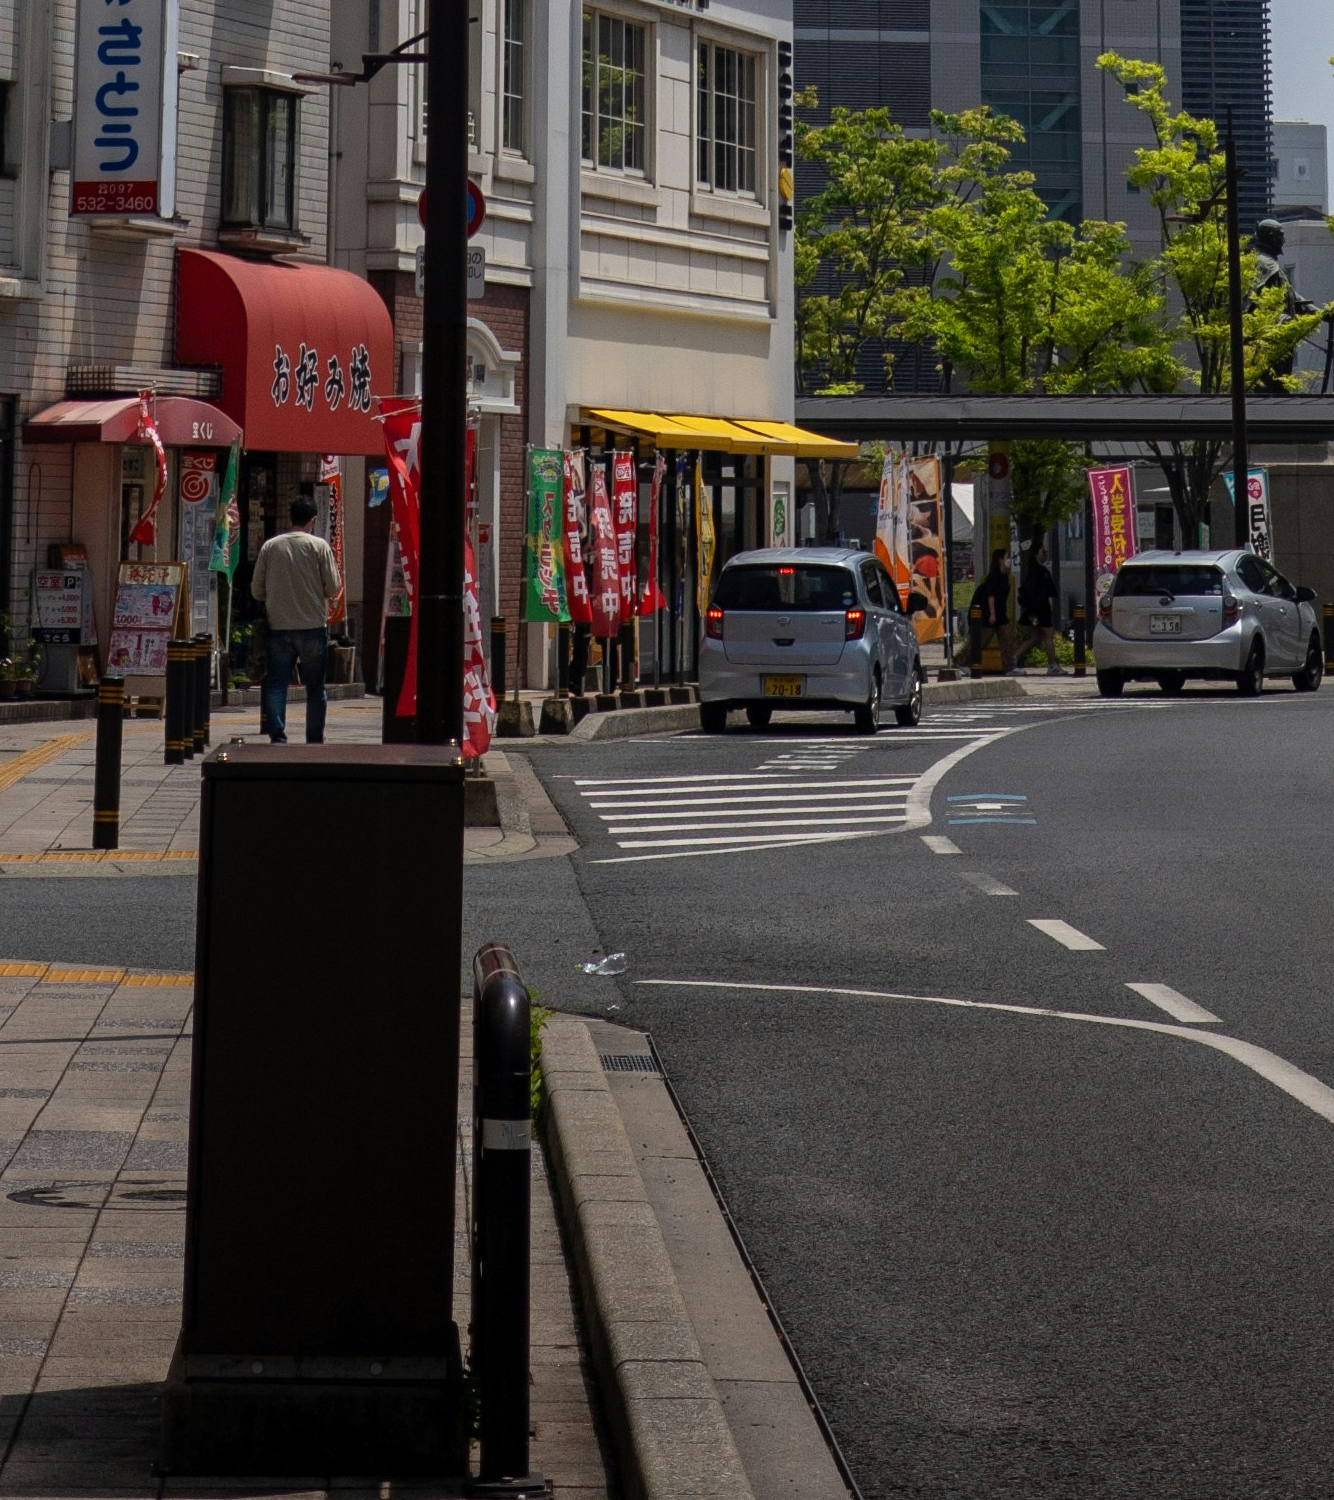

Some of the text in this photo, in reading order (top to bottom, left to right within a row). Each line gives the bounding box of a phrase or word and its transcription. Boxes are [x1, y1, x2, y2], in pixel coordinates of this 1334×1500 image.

[93, 17, 143, 171] さとう
[76, 195, 154, 212] 532-3460
[271, 342, 371, 413] お好み焼
